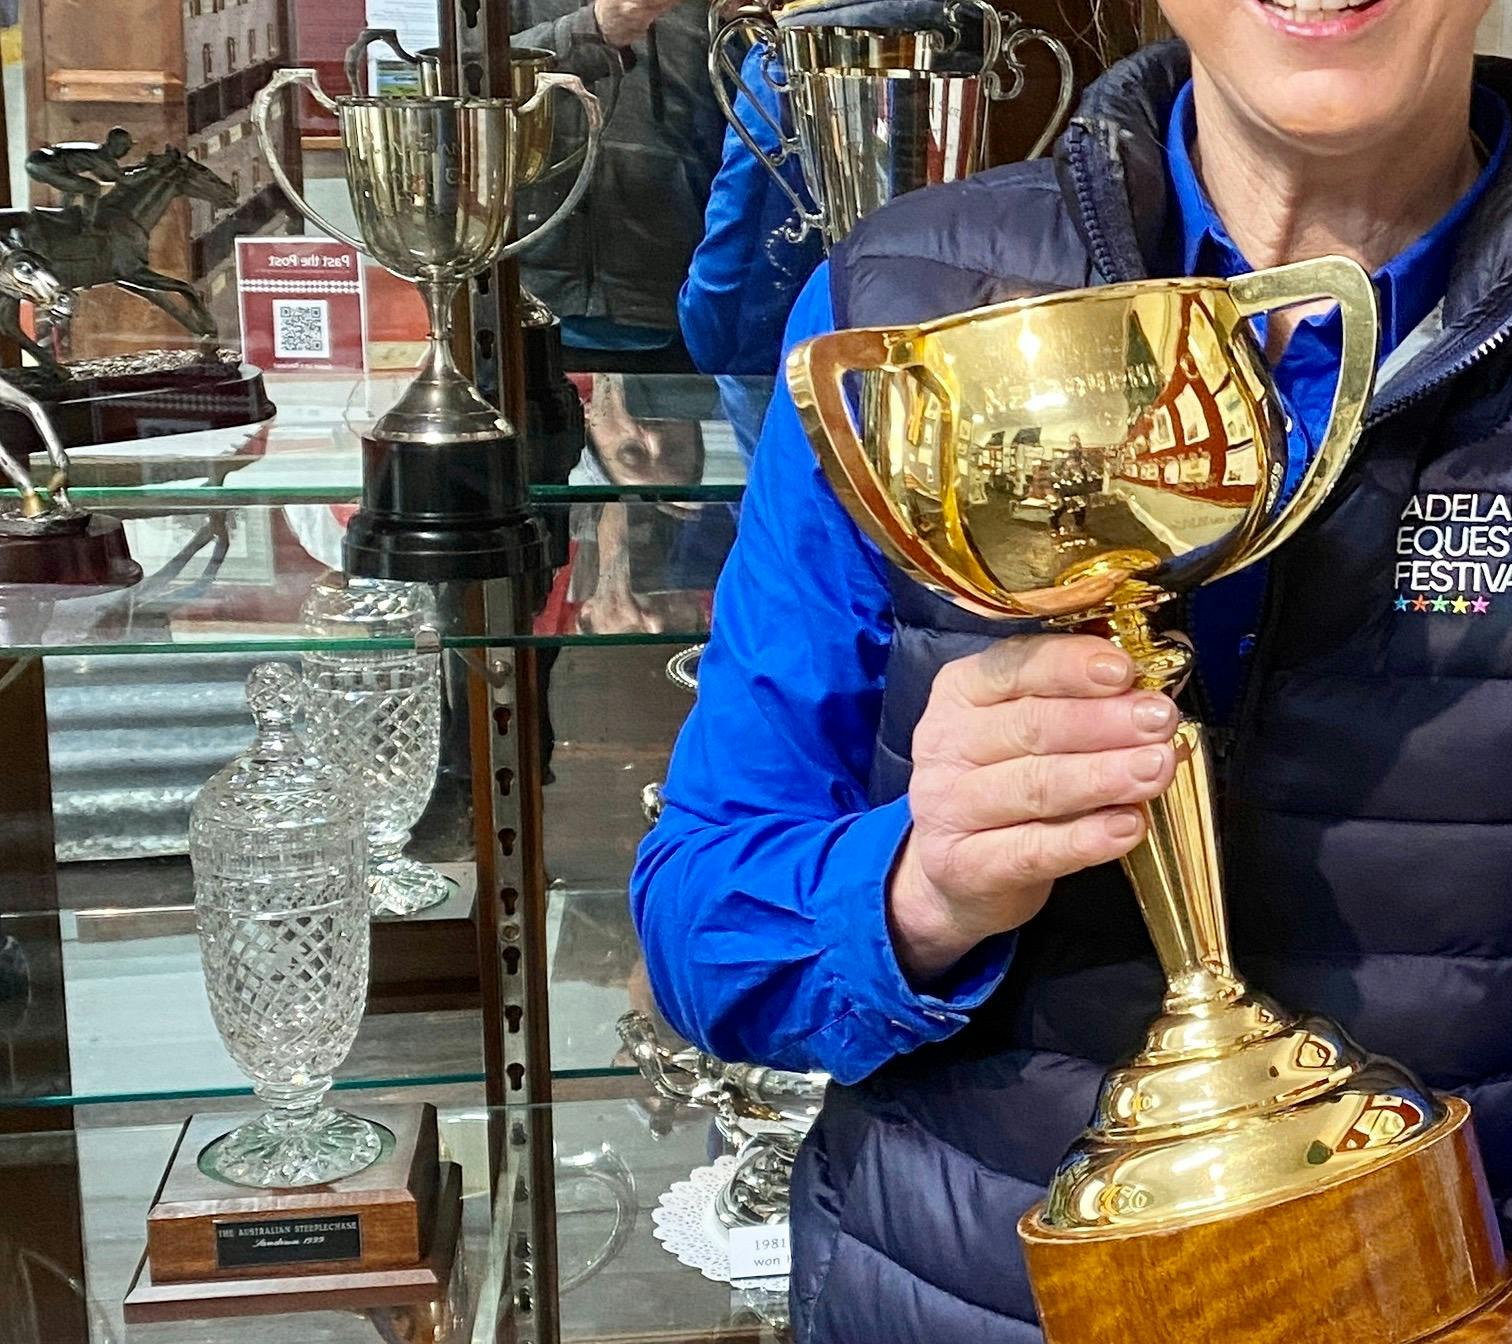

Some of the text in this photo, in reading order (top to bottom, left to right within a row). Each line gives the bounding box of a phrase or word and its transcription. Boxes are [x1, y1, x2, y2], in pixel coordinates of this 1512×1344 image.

[218, 1221, 357, 1238] THE AUSTRALIAN STEEPLECHASE
[755, 1238, 785, 1250] 1981
[753, 1257, 781, 1267] won
